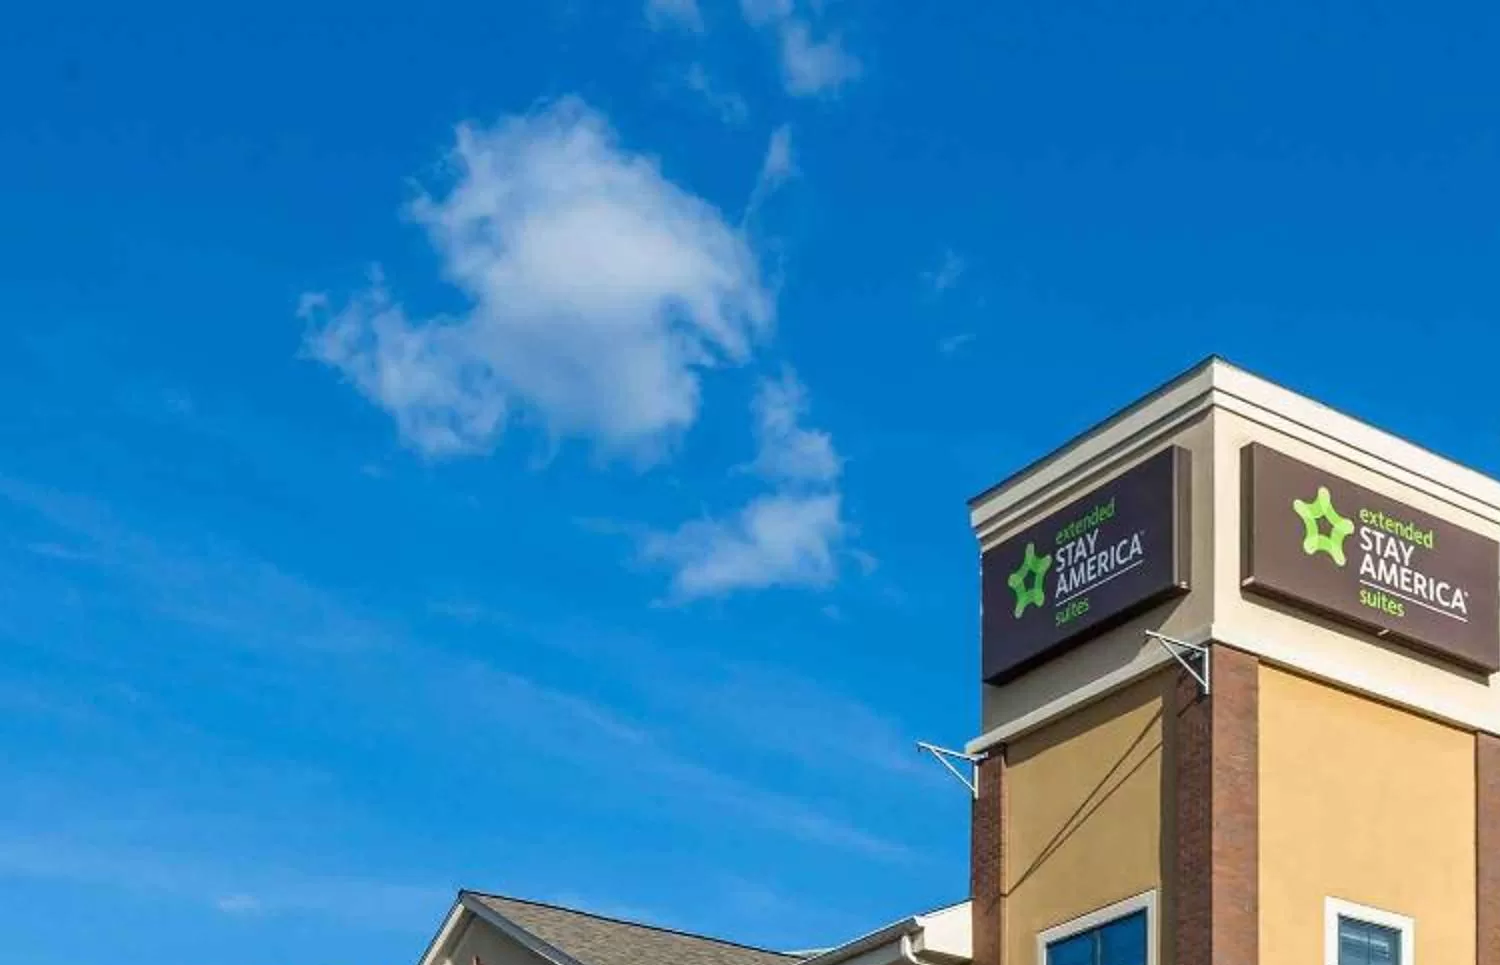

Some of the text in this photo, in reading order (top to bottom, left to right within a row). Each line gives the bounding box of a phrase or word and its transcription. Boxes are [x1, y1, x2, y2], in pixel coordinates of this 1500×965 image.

[1056, 497, 1116, 544] extended
[1359, 508, 1434, 549] extended
[1055, 532, 1144, 598] AMERICA
[1056, 528, 1099, 573] STAY
[1359, 527, 1415, 567] STAY
[1359, 553, 1469, 614] AMERICA
[1359, 587, 1405, 617] suites
[1055, 599, 1090, 627] suites
